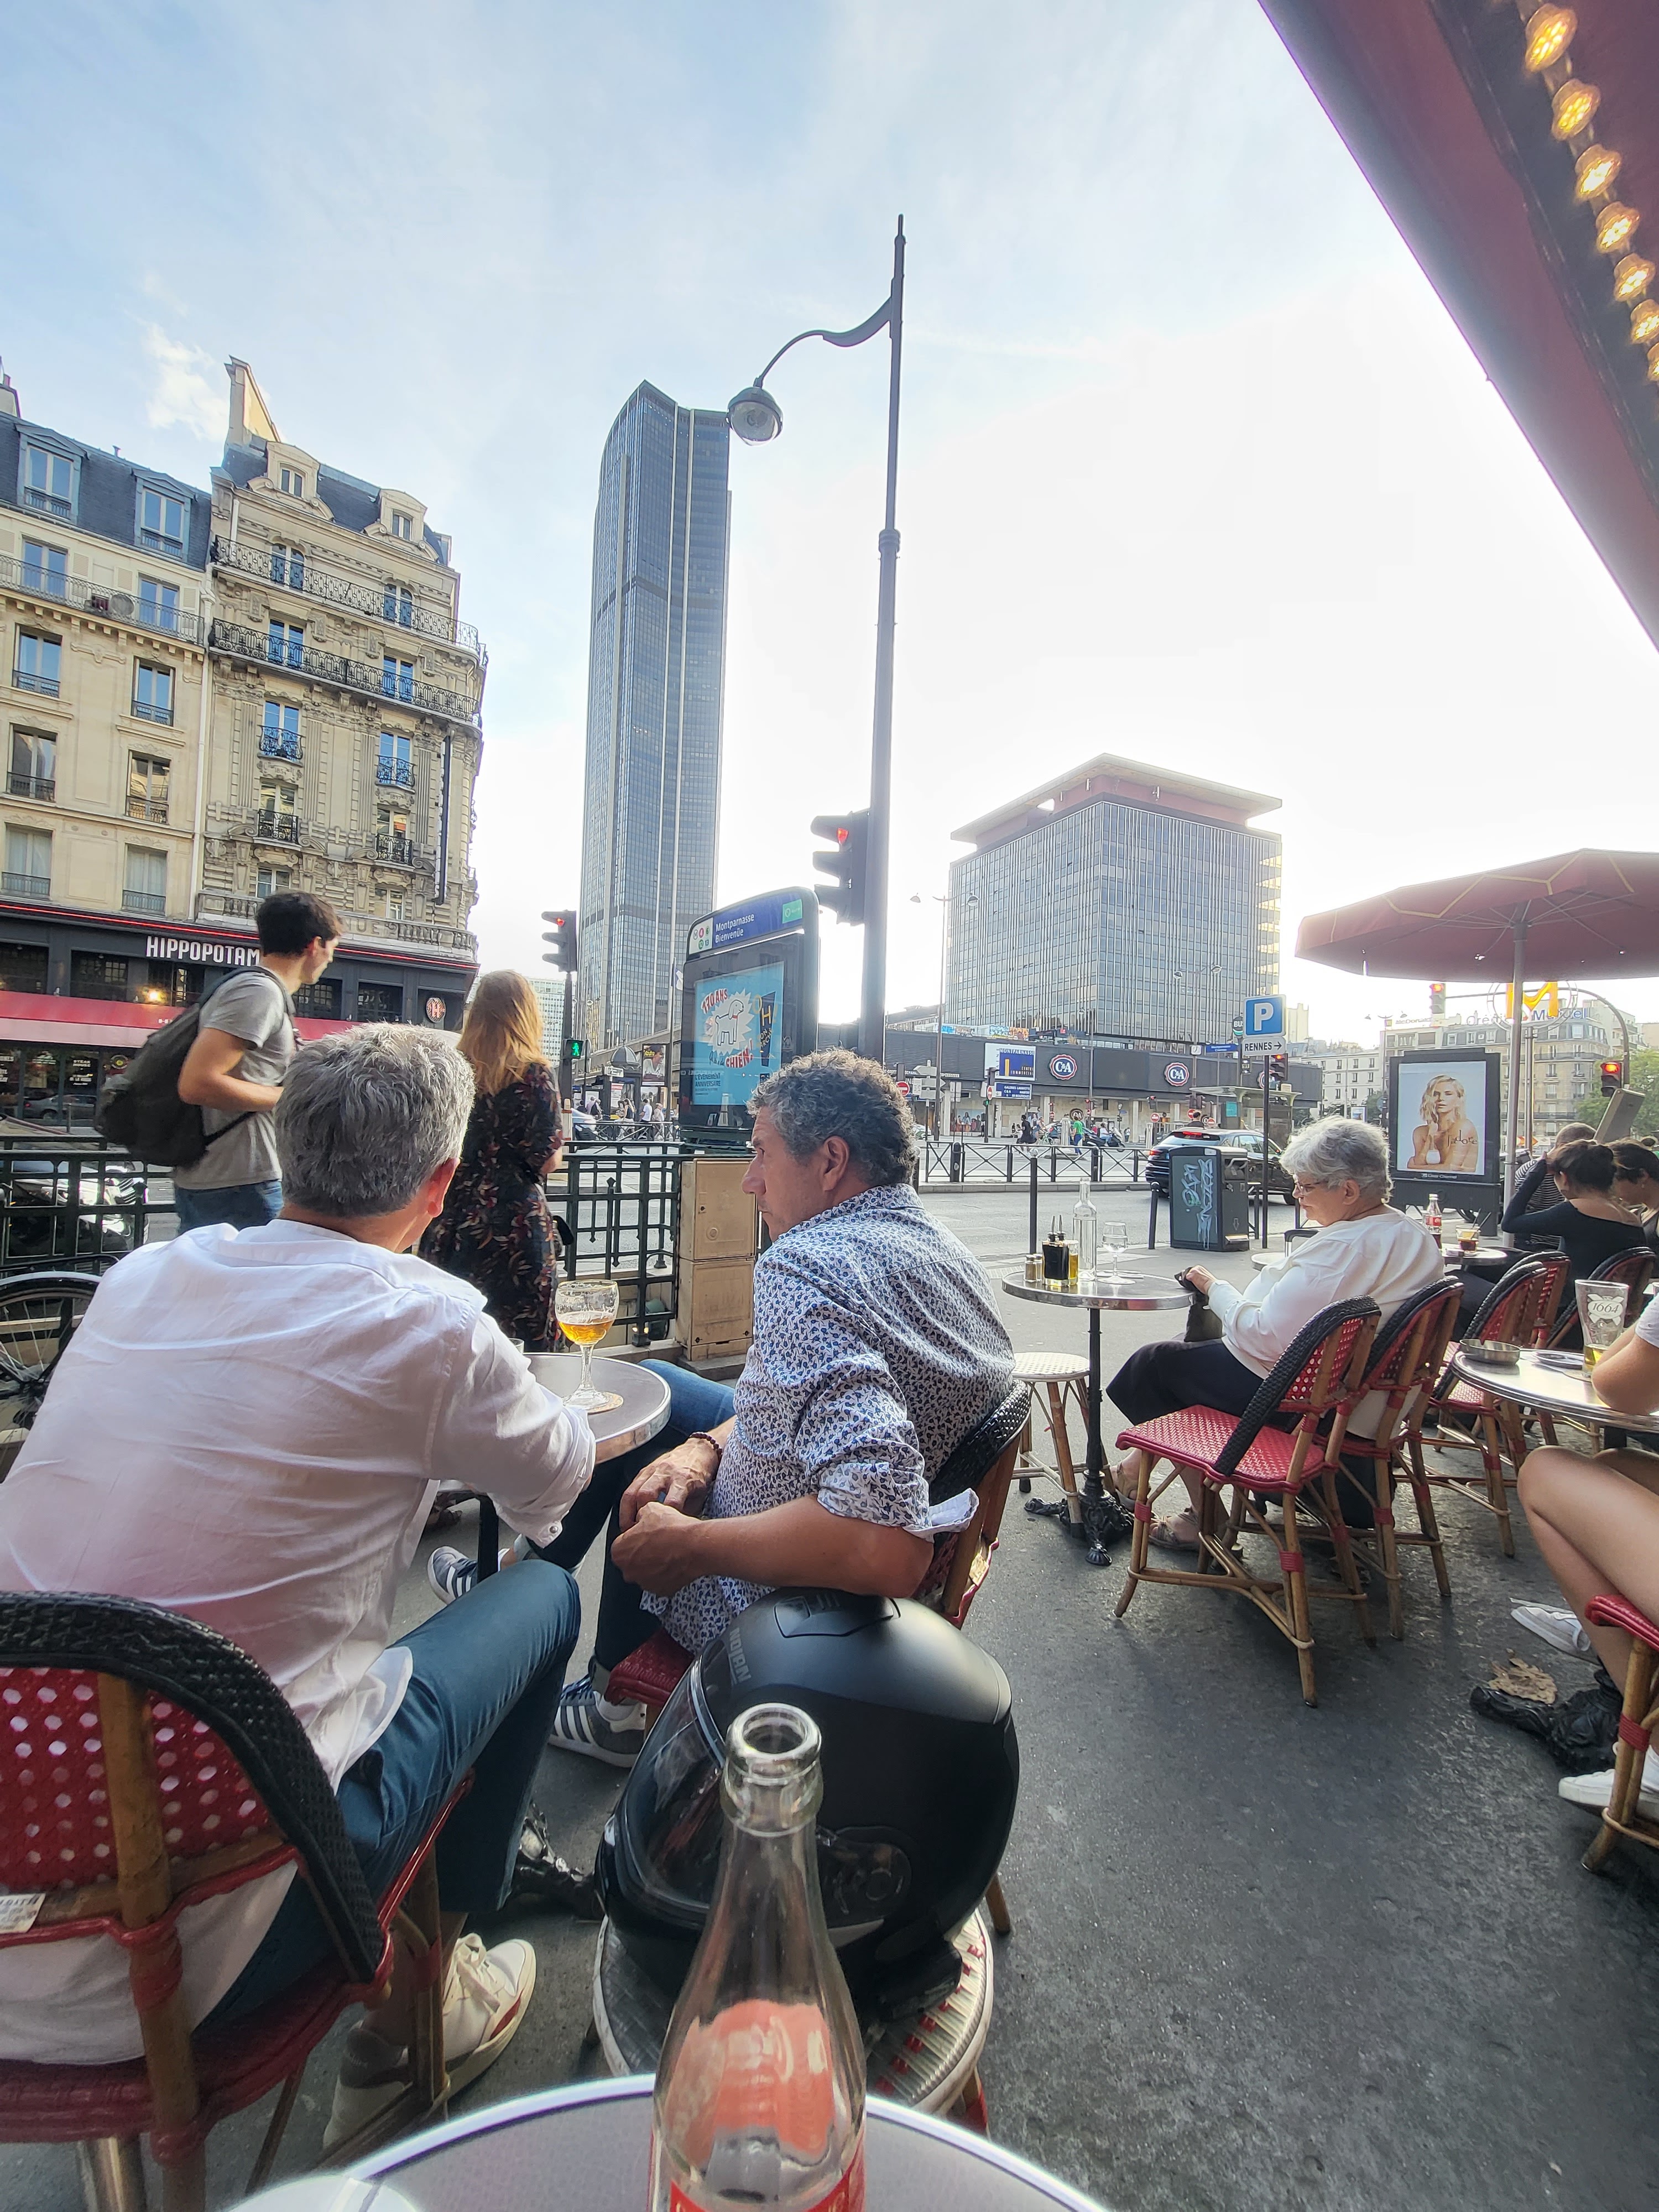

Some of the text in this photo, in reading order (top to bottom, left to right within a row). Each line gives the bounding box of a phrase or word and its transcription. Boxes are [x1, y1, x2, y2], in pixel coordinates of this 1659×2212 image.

[716, 914, 754, 932] Montparnasse
[715, 928, 744, 943] Bienvenüe
[146, 935, 260, 967] HIPPOPOTAM
[1254, 1002, 1274, 1031] P
[1244, 1042, 1272, 1051] RENNES
[1055, 1061, 1072, 1073] C&A
[1170, 1068, 1185, 1080] C&A
[1592, 1302, 1619, 1313] 1664
